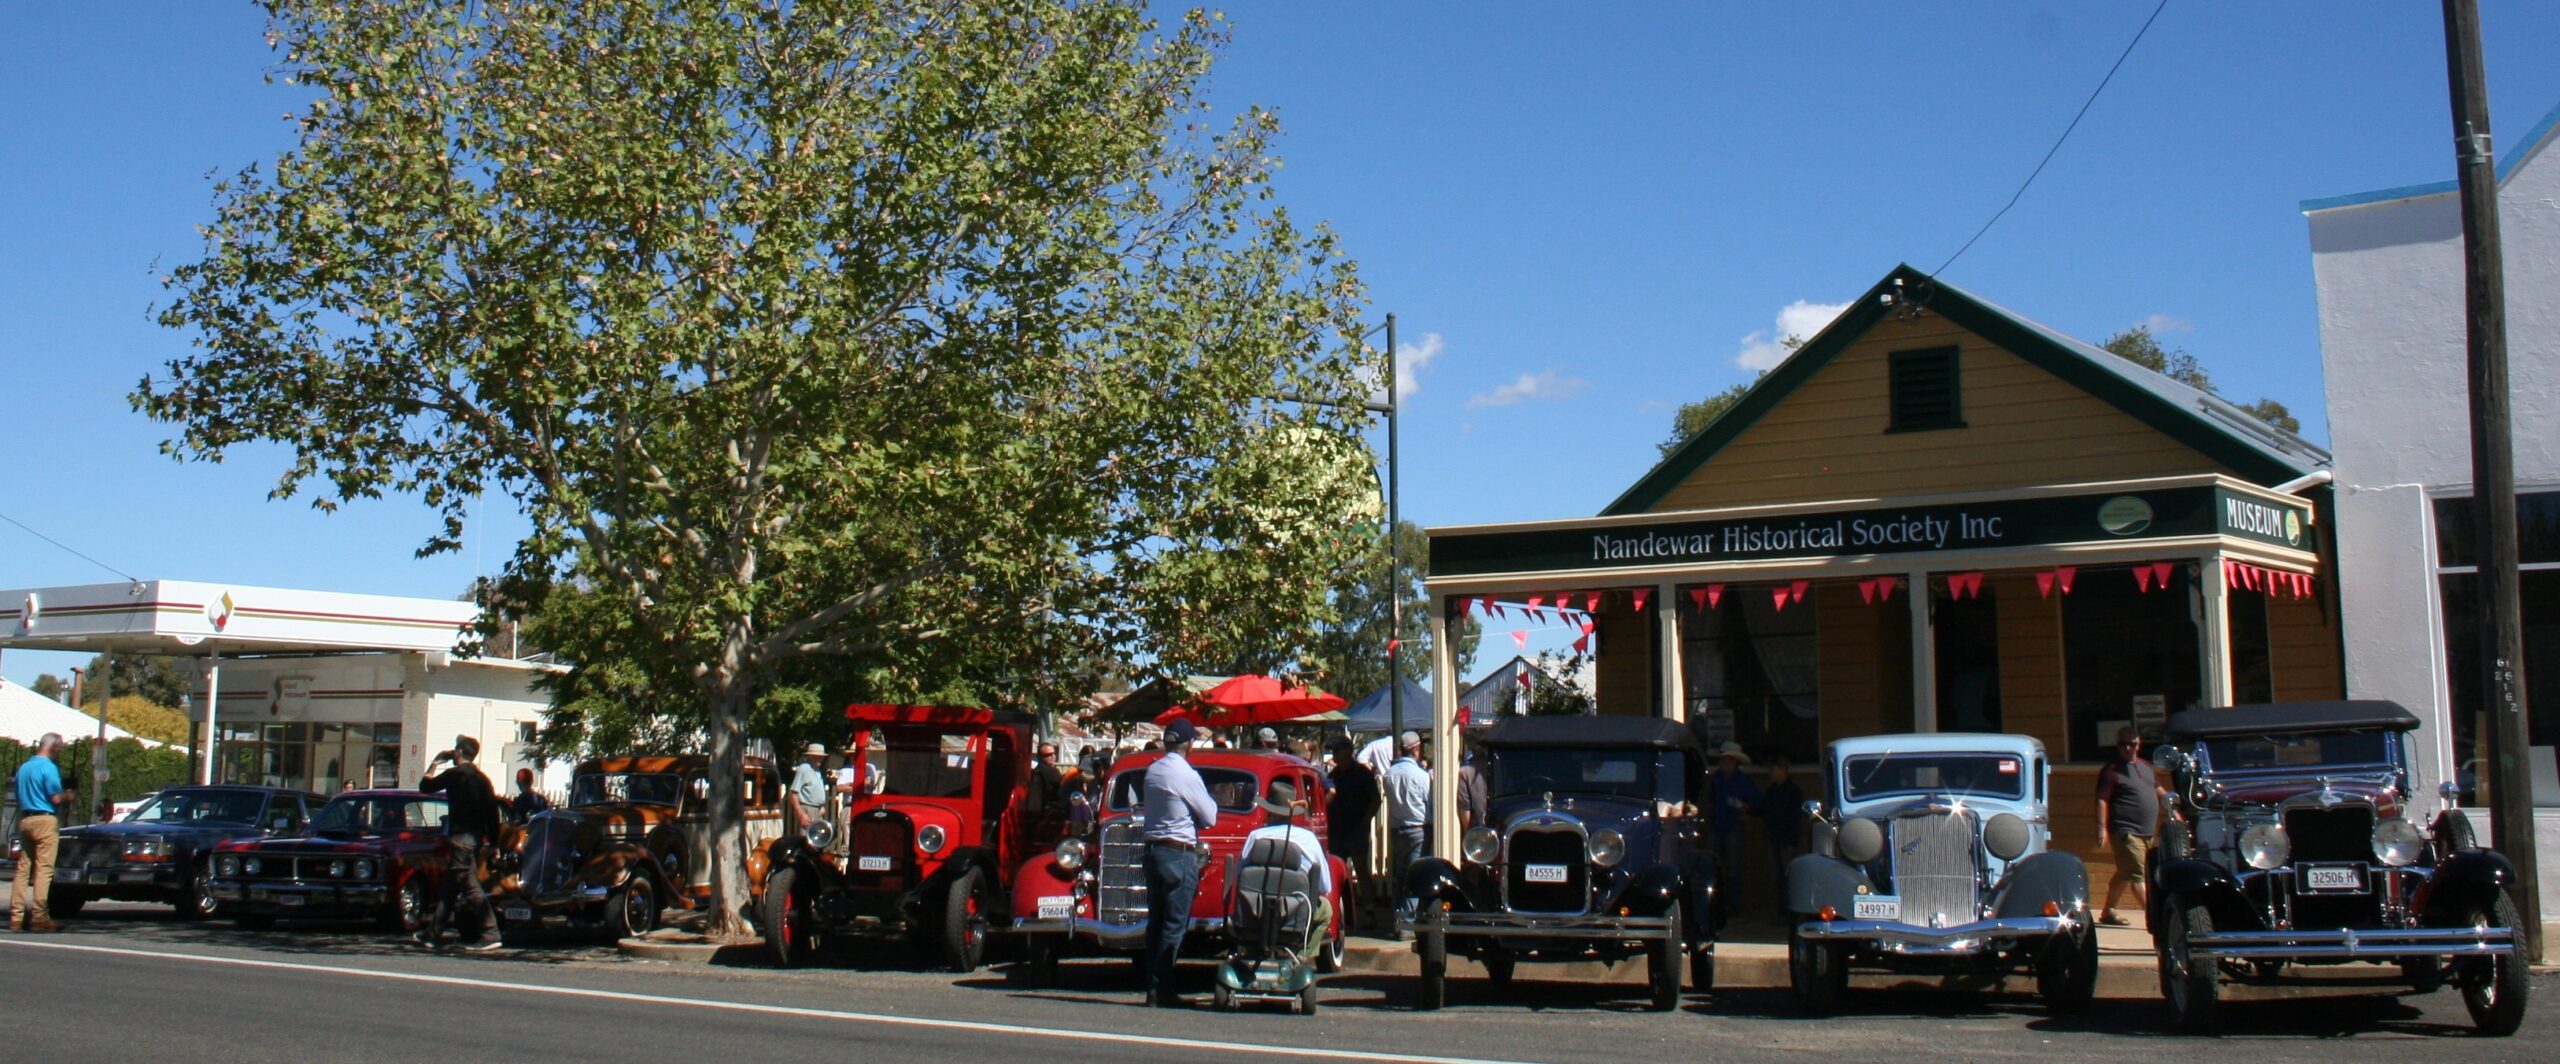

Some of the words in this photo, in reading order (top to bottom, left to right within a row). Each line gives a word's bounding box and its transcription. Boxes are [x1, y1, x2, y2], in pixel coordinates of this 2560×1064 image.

[2226, 497, 2283, 538] MUSEUM
[1593, 531, 1715, 560] Nandewar
[1723, 520, 1843, 553] Historical
[1852, 514, 1950, 549] Society
[1960, 512, 2003, 540] Inc
[2312, 871, 2344, 883] 32506
[2346, 871, 2354, 883] H
[1042, 907, 1063, 917] 59604
[1859, 904, 1886, 915] 34997
[1888, 904, 1895, 915] H
